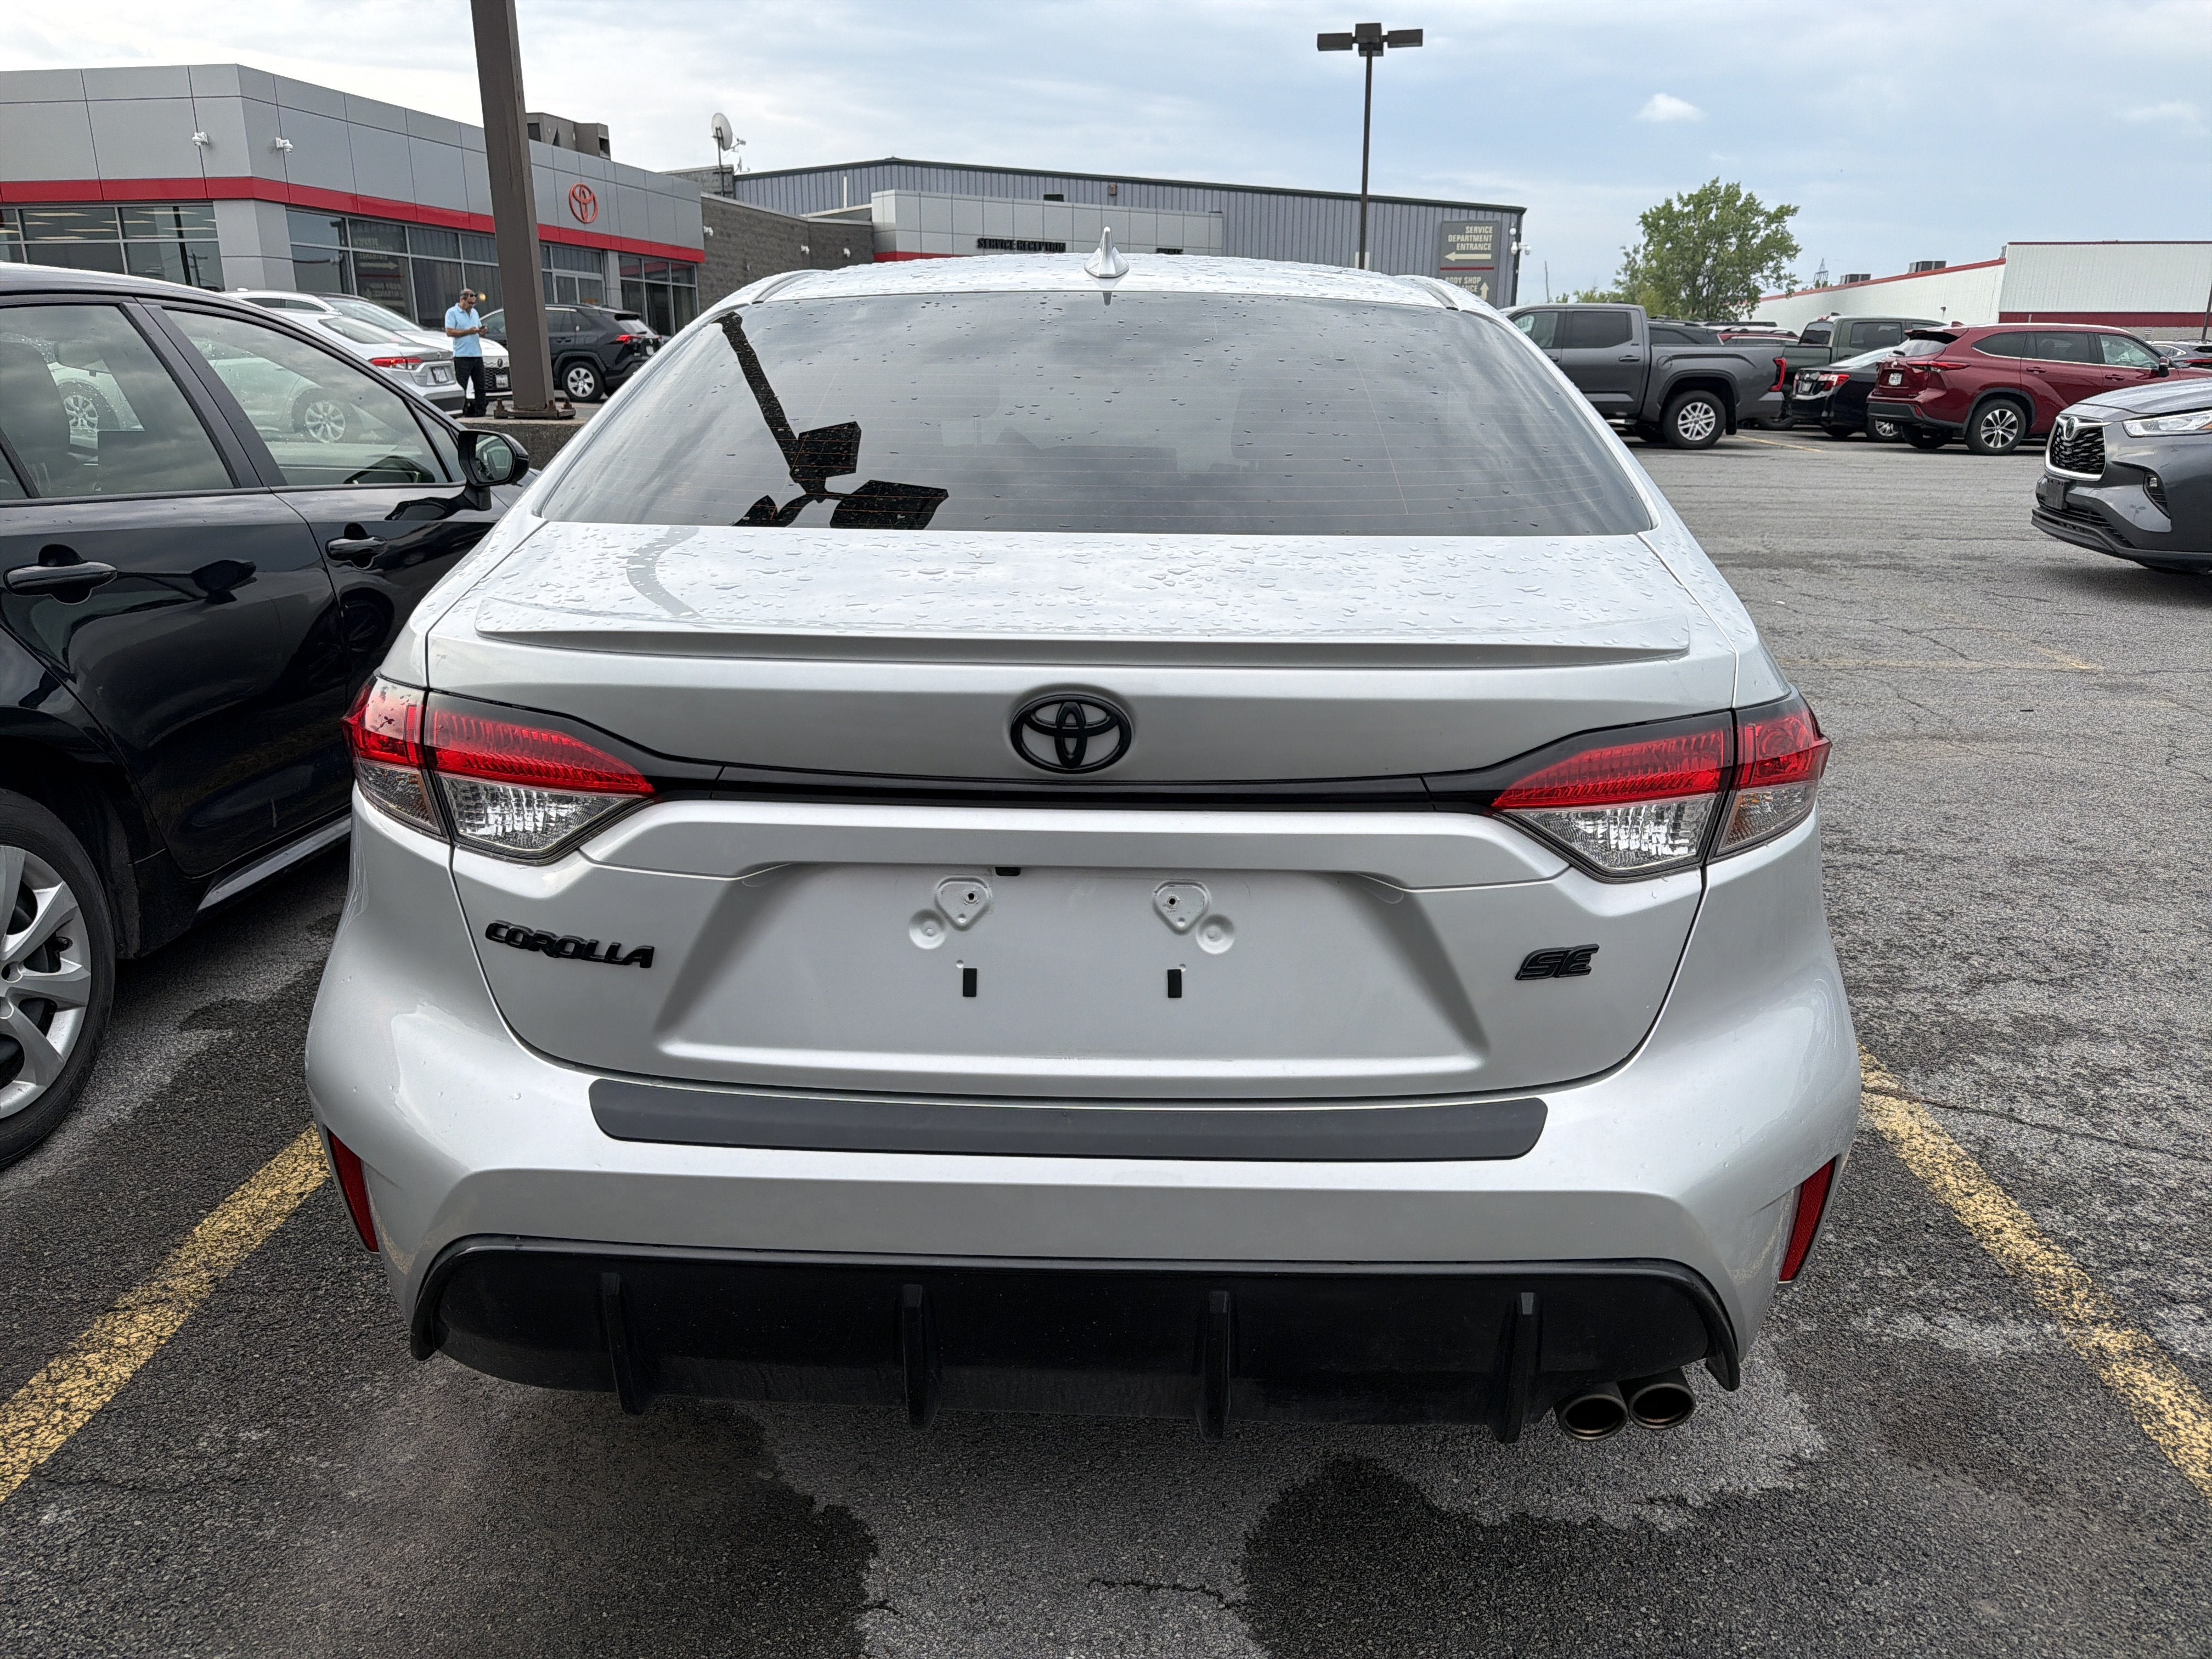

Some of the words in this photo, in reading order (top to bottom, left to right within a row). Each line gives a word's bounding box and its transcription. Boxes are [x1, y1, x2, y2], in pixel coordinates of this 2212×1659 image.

[977, 238, 1015, 250] SERVICE
[1017, 240, 1066, 252] RECEPTION
[485, 920, 654, 968] COROLLA
[1515, 944, 1600, 980] SE
